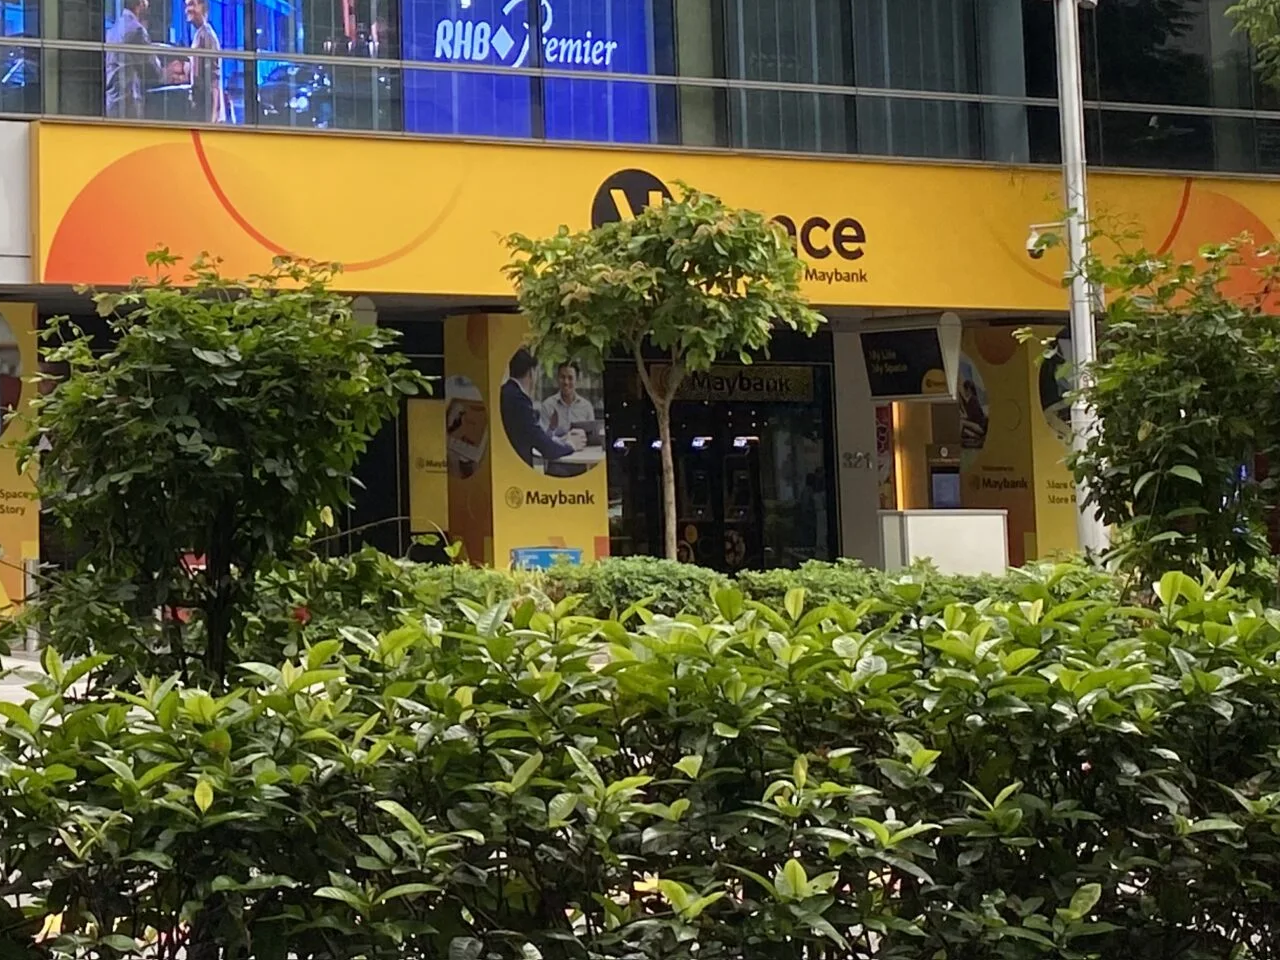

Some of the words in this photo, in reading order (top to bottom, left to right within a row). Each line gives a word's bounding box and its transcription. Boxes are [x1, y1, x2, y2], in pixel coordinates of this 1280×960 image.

[435, 19, 492, 61] RHB
[805, 268, 868, 284] Maybank
[692, 370, 791, 397] Maybank
[526, 489, 595, 508] Maybank
[0, 503, 26, 517] Story
